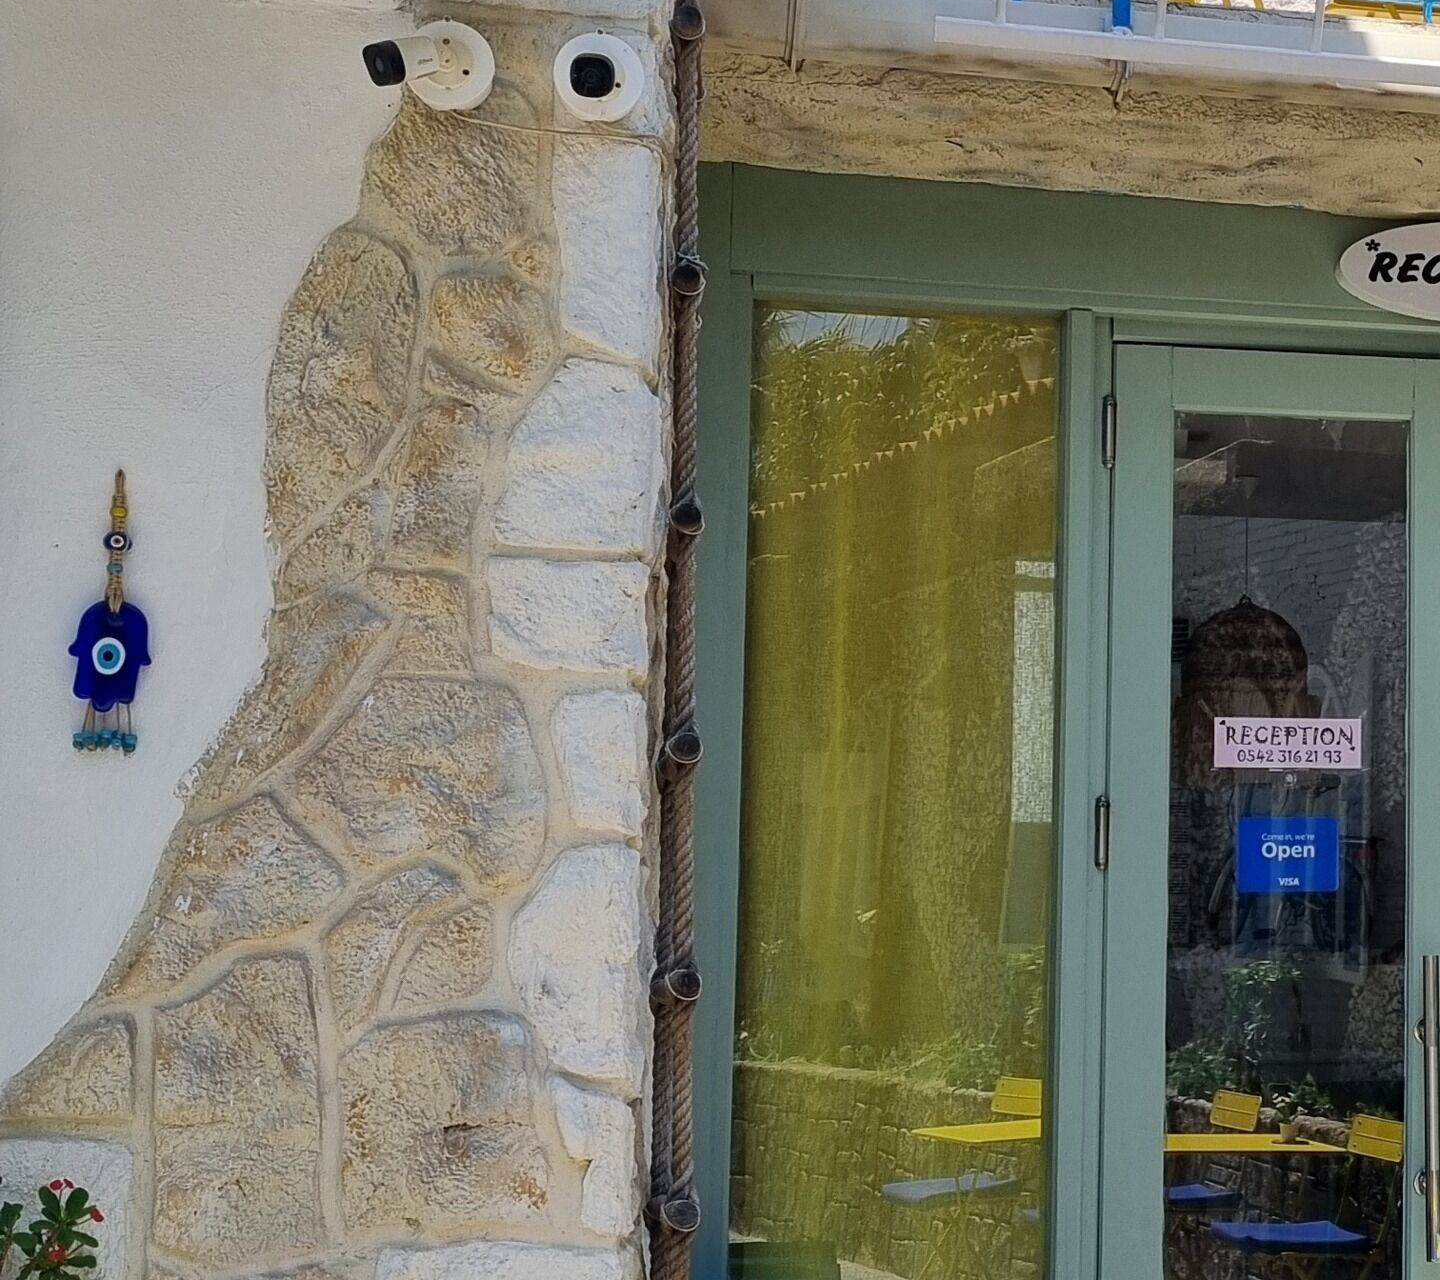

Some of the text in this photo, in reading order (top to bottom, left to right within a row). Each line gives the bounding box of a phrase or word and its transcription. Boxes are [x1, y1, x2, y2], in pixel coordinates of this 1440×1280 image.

[1225, 725, 1354, 746] RECEPTION
[1236, 749, 1342, 764] 0542 316 21 93
[1261, 832, 1284, 841] Come
[1261, 841, 1316, 862] Open
[1278, 876, 1300, 887] VISA
